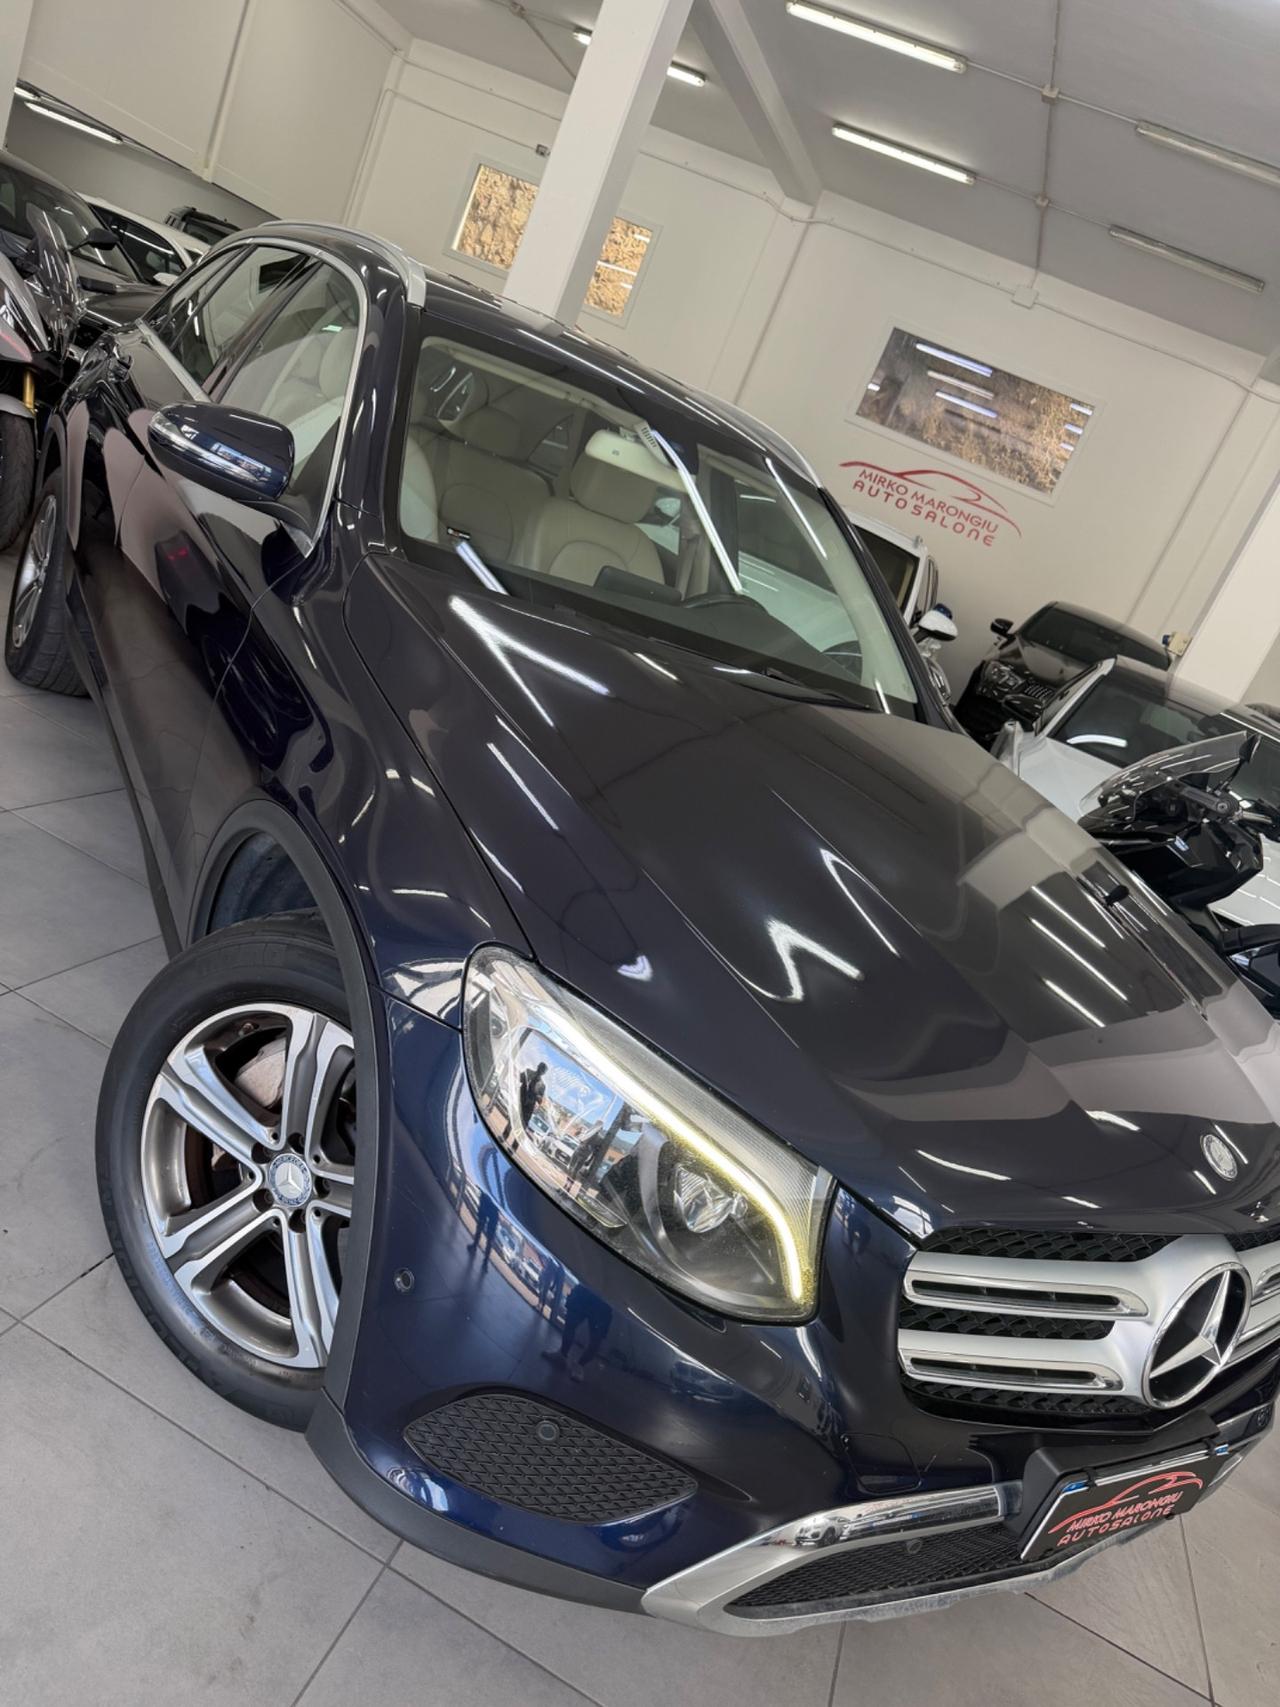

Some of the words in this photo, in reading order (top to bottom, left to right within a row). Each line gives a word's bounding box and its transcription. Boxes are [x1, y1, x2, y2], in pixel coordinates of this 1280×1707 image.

[853, 480, 996, 547] AUTOSALONE
[859, 469, 908, 496] MIRKO
[911, 491, 999, 534] MARONGIU
[1056, 1504, 1175, 1546] AUTOSALONE
[1066, 1511, 1112, 1533] MIRKO
